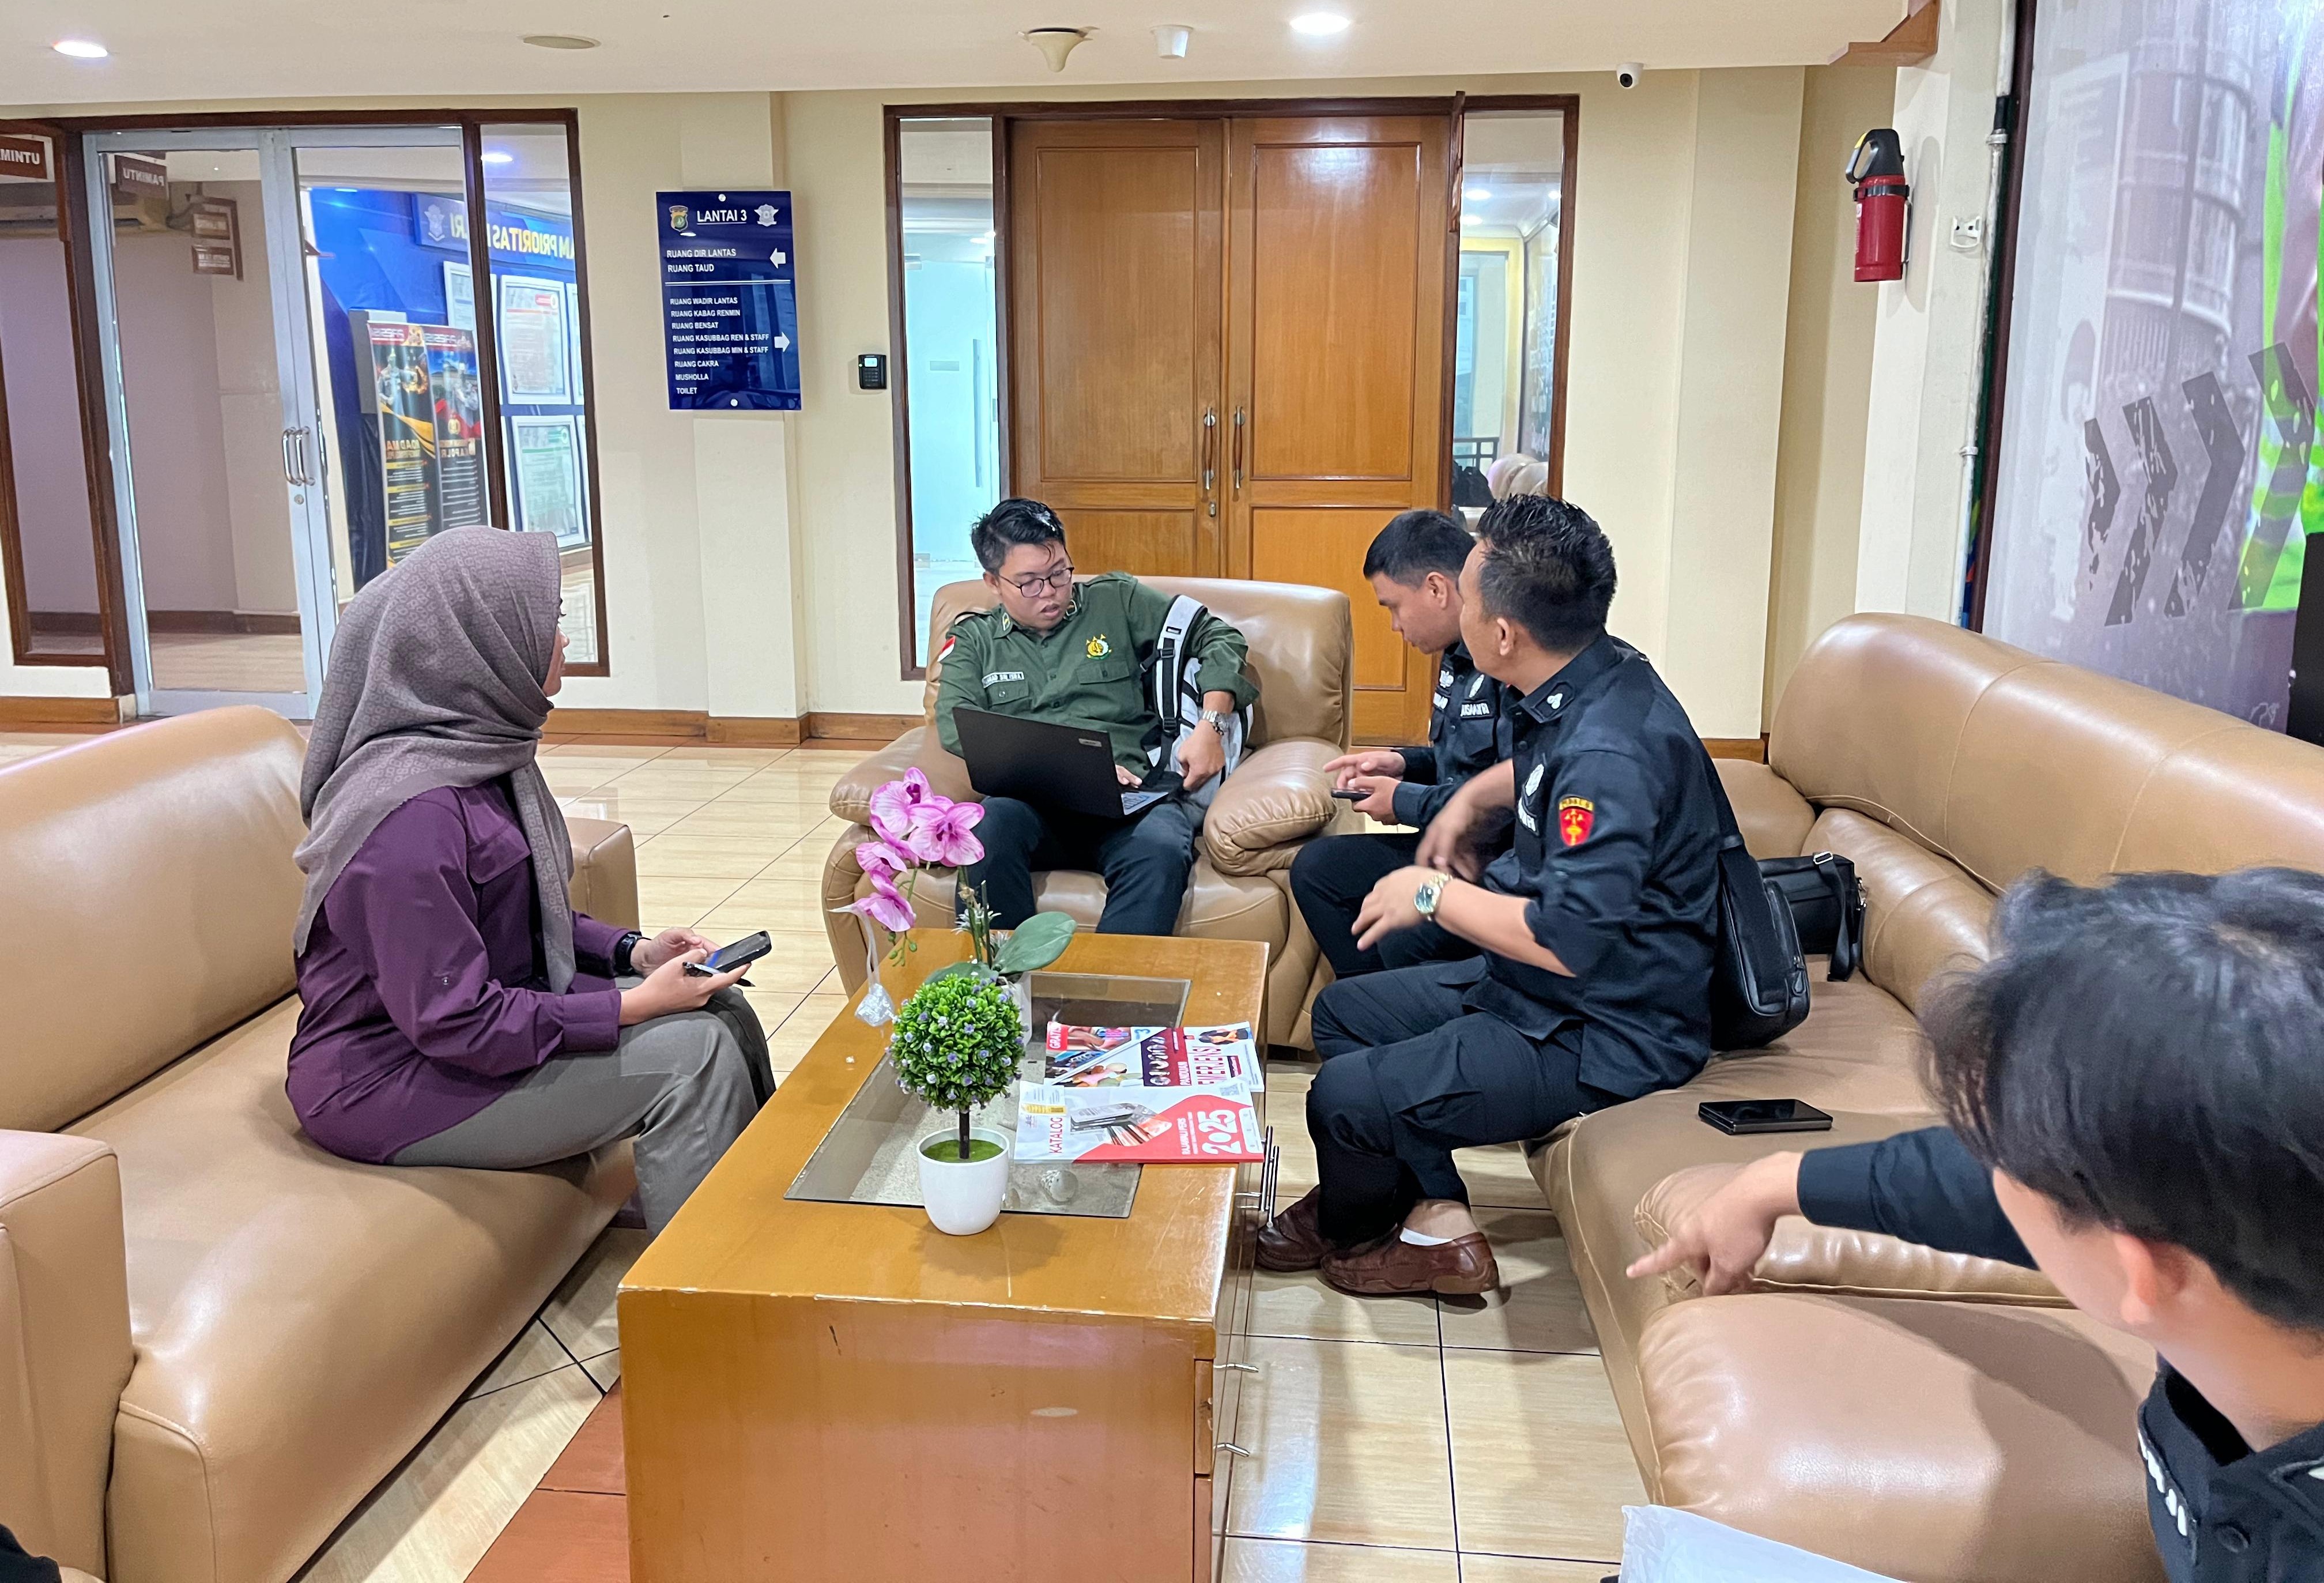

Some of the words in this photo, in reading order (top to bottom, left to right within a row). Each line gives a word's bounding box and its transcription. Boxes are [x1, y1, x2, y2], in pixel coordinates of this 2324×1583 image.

[0, 148, 40, 165] MINTU
[697, 210, 737, 223] LANTAI
[741, 209, 748, 221] 3
[666, 250, 692, 258] RUANG
[708, 248, 737, 257] LANTAS
[695, 263, 714, 272] TAUD
[1049, 1026, 1062, 1049] GRATIS
[1177, 1061, 1192, 1086] PANDUAN
[1176, 1118, 1188, 1130] PERS
[1197, 1109, 1243, 1155] 2025
[1049, 1117, 1063, 1154] KATALOG
